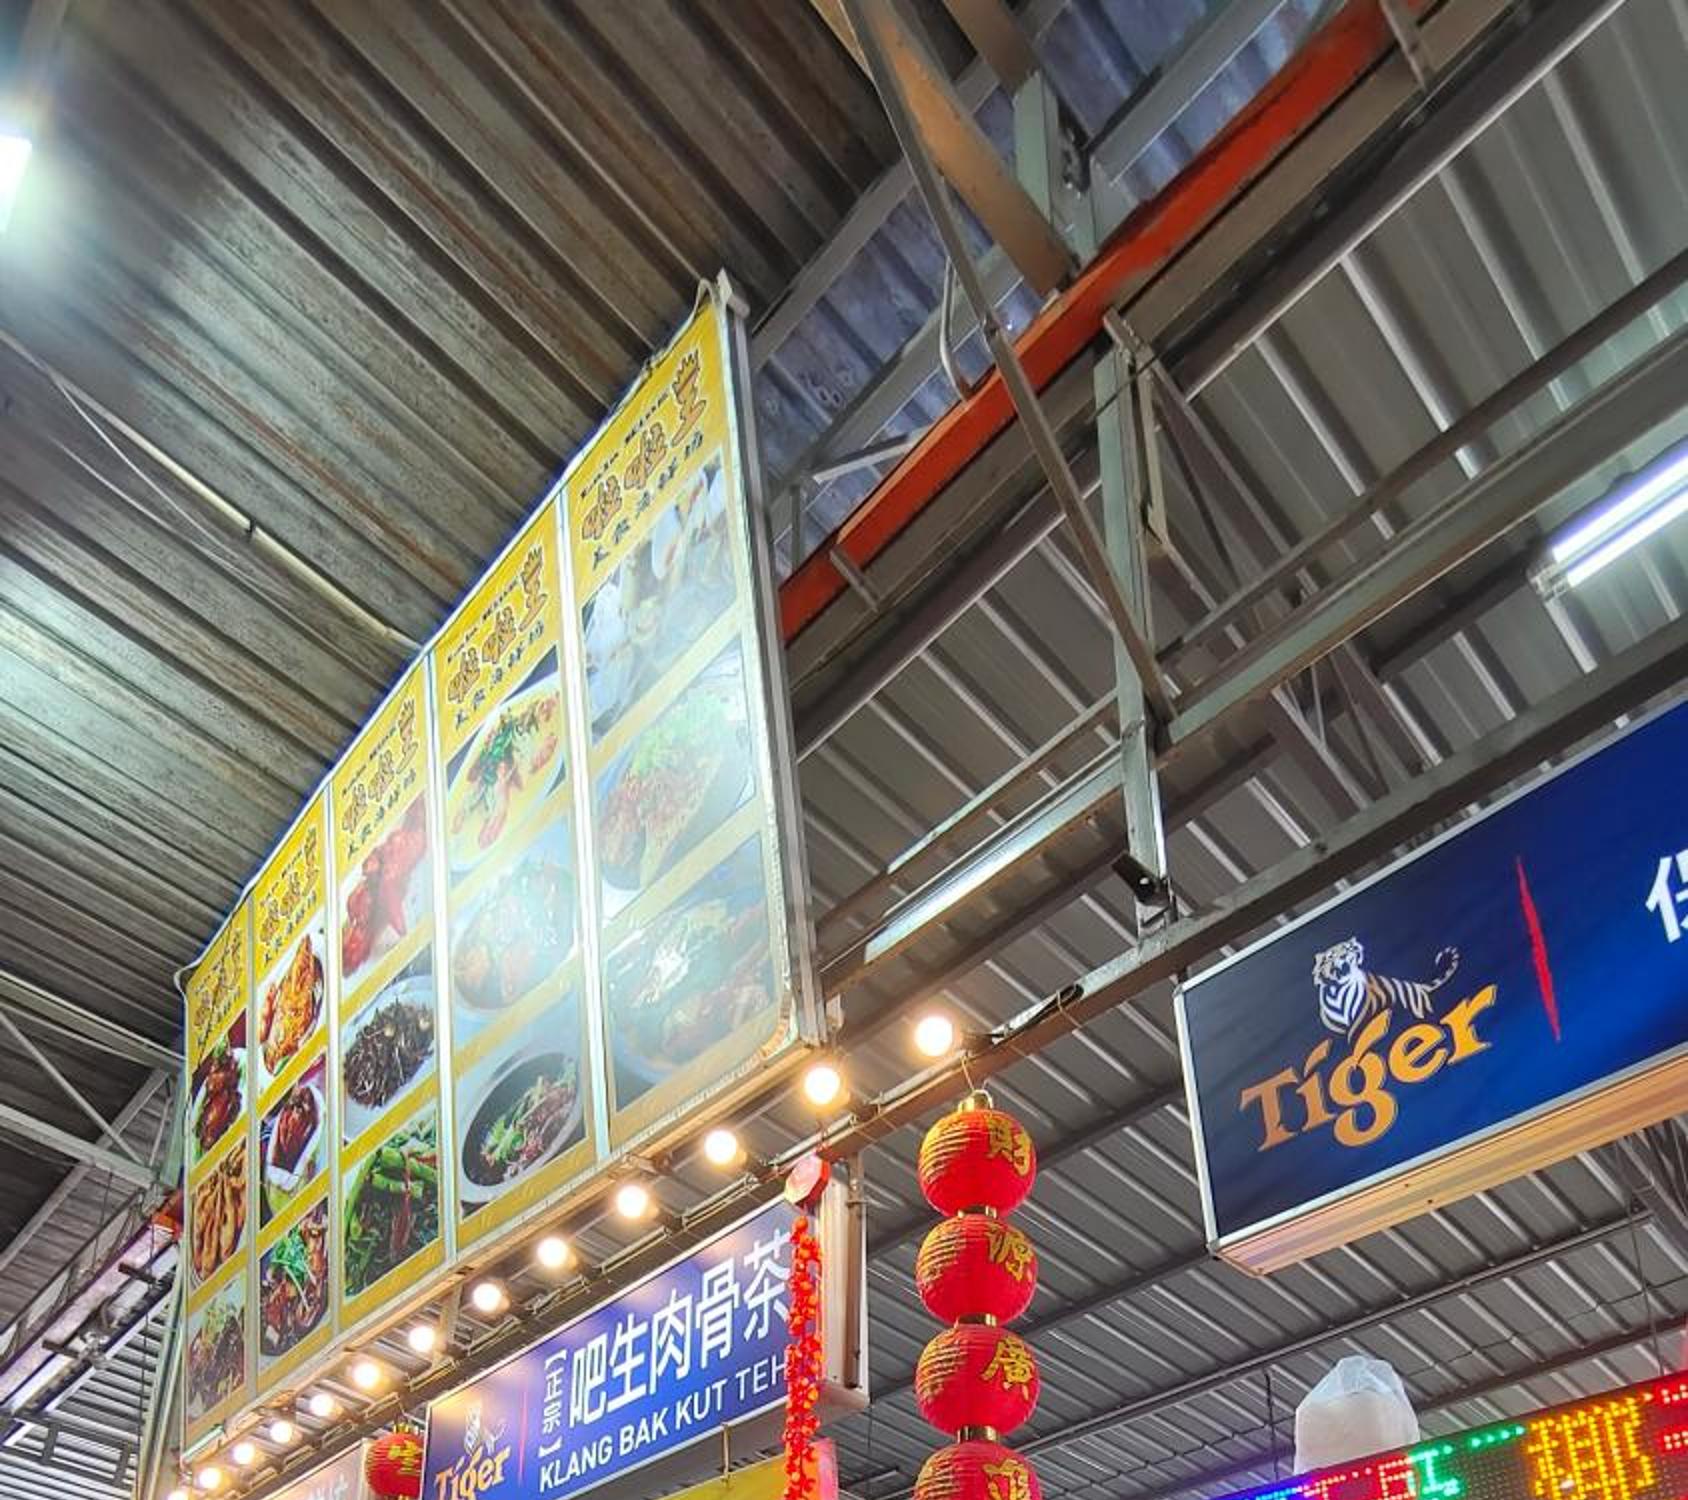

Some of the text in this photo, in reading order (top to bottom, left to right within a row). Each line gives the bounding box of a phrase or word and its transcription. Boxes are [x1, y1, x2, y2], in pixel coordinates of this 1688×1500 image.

[1239, 984, 1498, 1154] Tiger
[569, 1228, 791, 1428] 吧生肉骨茶
[539, 1354, 788, 1493] KLANG BAK KUT TEH
